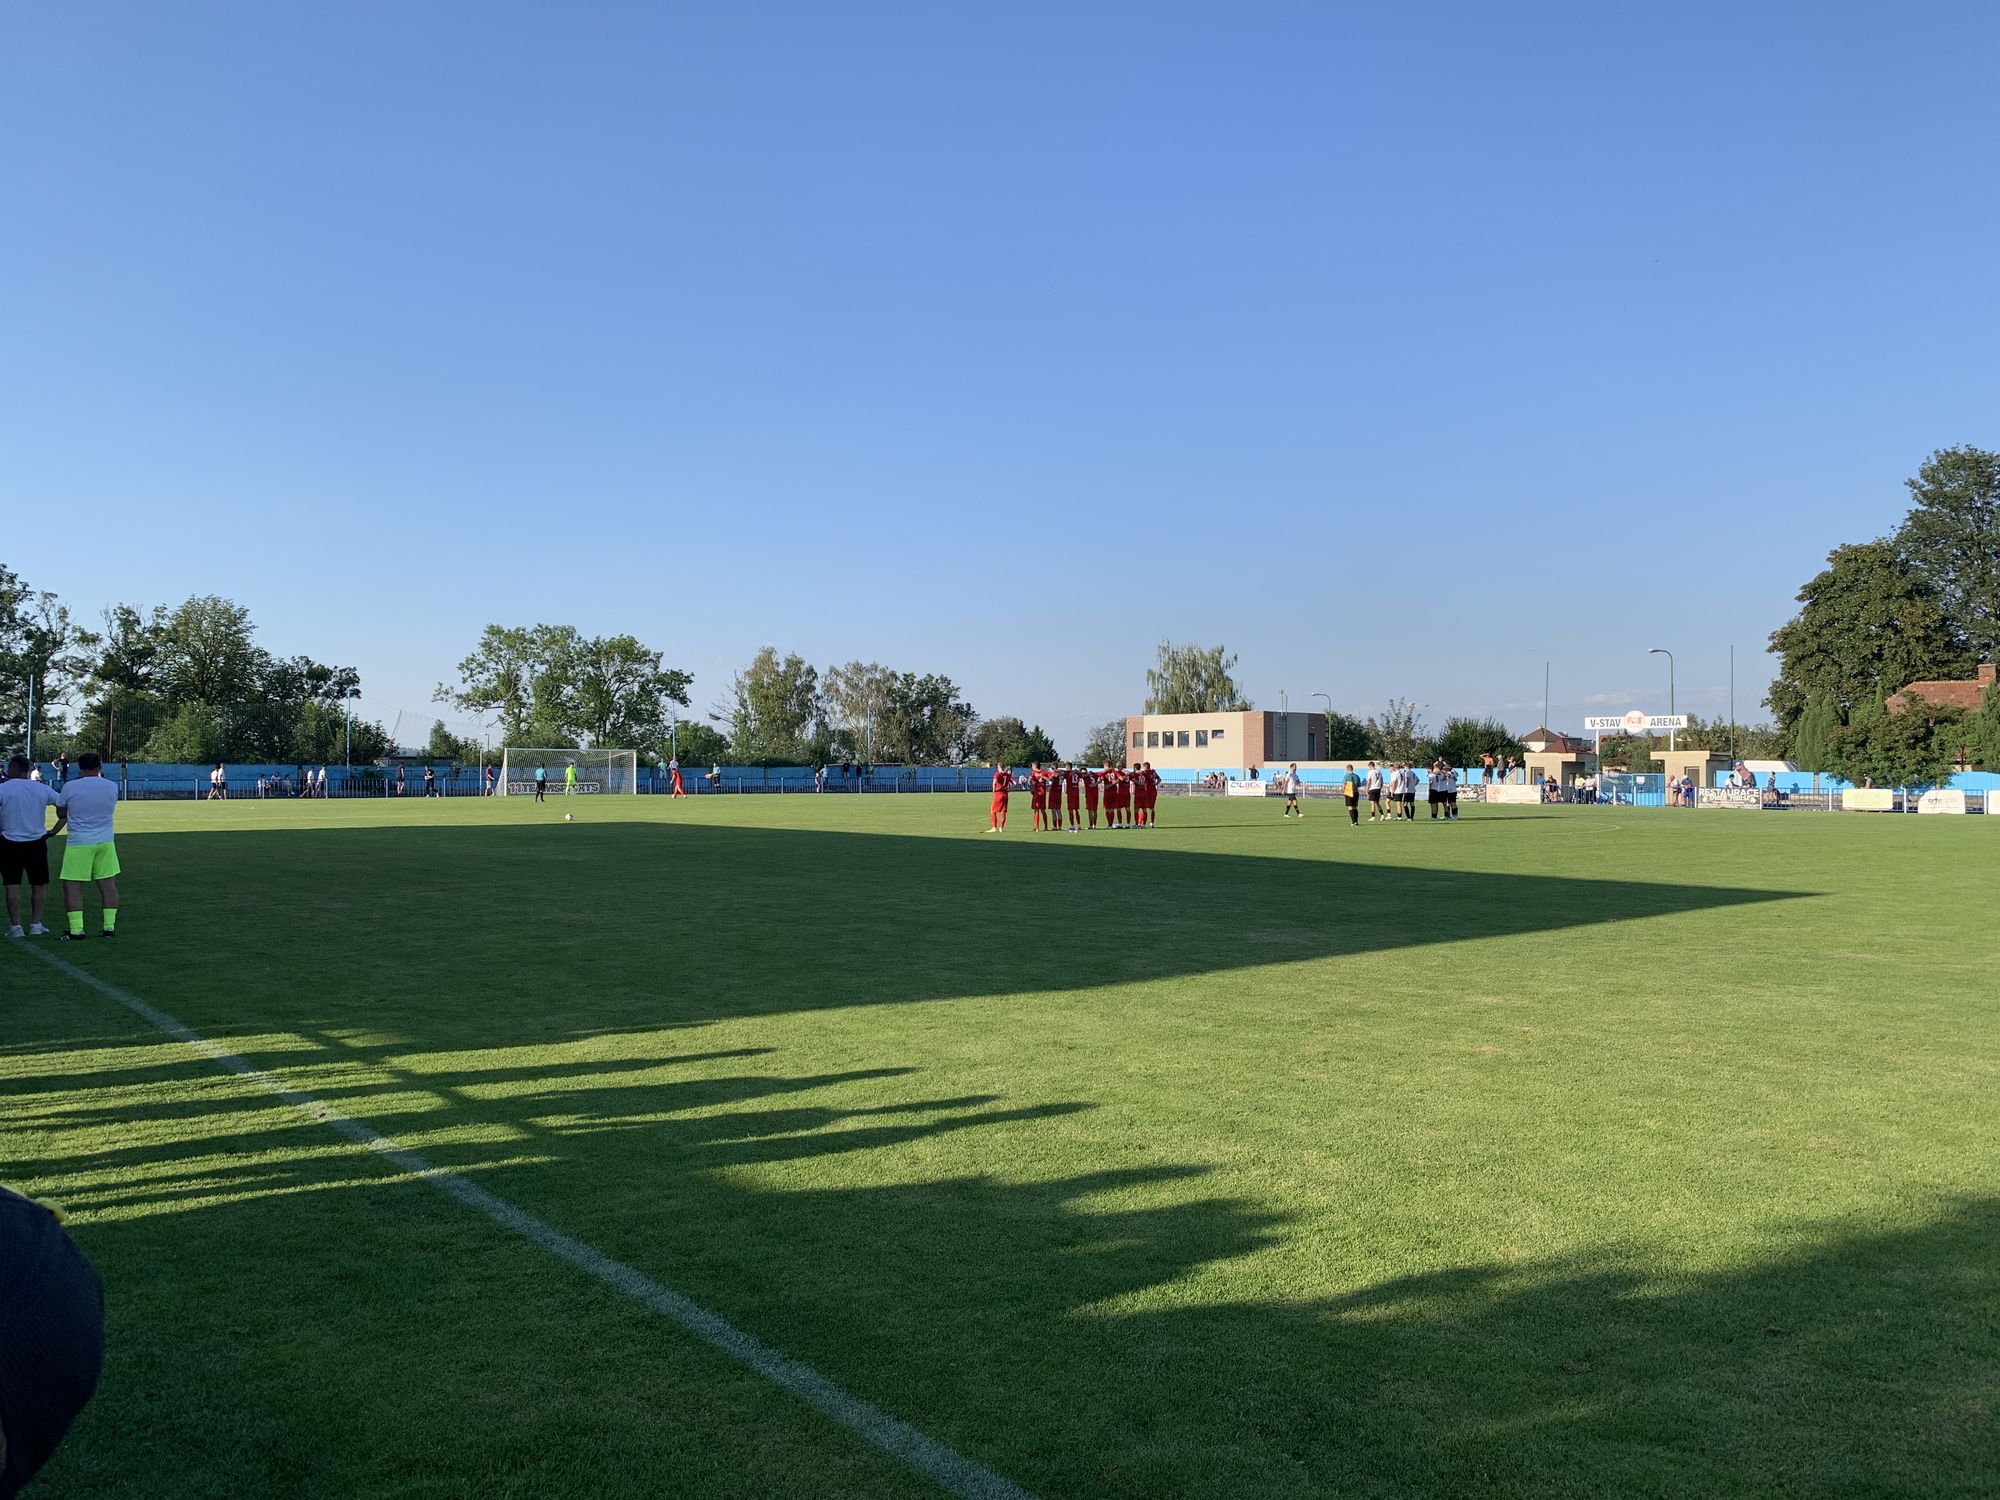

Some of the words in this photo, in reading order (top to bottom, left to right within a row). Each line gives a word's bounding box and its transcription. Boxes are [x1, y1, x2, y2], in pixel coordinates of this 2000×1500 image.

[1590, 718, 1621, 728] V-STAV
[1650, 717, 1682, 726] ARENA
[1698, 788, 1759, 797] RESTAURACE
